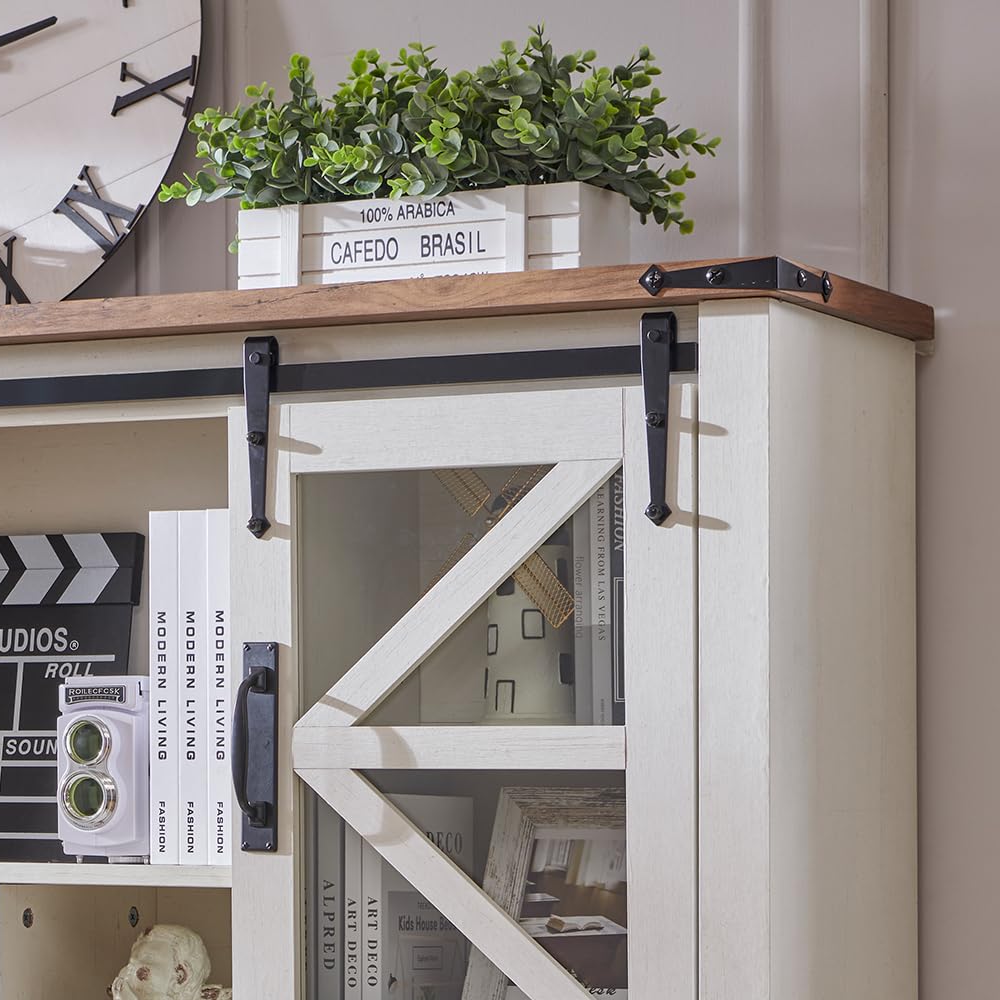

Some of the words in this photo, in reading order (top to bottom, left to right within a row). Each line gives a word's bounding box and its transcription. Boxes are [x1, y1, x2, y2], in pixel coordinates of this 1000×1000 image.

[111, 55, 197, 117] X
[360, 206, 393, 224] 100%
[396, 200, 455, 221] ARABICA
[330, 236, 399, 265] CAFEDO
[420, 229, 486, 258] BRASIL
[575, 556, 585, 586] flower
[597, 547, 606, 576] FROM
[597, 580, 606, 601] LAS
[597, 606, 606, 642] VEGAS
[44, 662, 94, 679] ROLL
[157, 611, 167, 689] MODERN
[186, 611, 196, 689] MODERN
[215, 611, 225, 689] MODERN
[5, 738, 57, 756] SOUN
[157, 700, 167, 761] LIVING
[186, 700, 196, 761] LIVING
[215, 700, 225, 761] LIVING
[158, 801, 167, 854] FASHION
[187, 801, 196, 854] FASHION
[216, 801, 225, 854] FASHION
[323, 879, 336, 970] ALPRED
[347, 898, 357, 932] ART
[367, 896, 378, 931] ART
[347, 940, 357, 988] DECO
[367, 939, 378, 987] DECO
